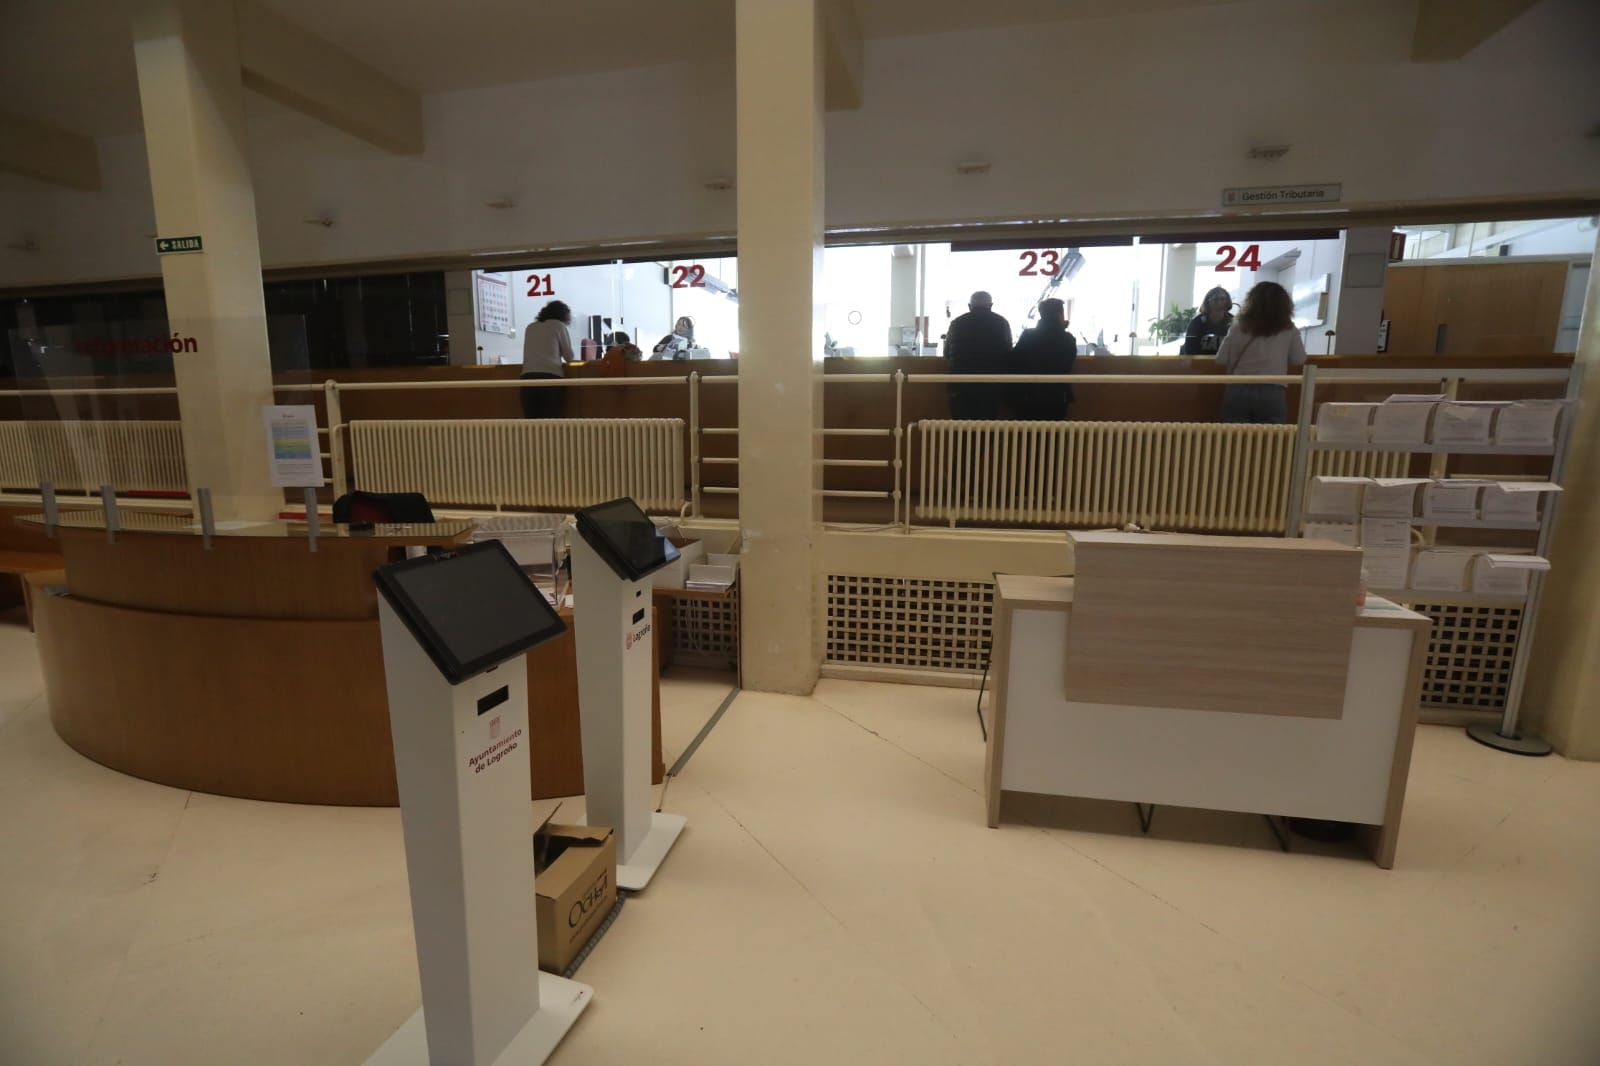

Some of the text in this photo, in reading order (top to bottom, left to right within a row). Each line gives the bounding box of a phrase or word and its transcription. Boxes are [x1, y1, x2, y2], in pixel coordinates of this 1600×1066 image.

[1242, 189, 1325, 202] Gestión Tributaria
[171, 239, 200, 251] SALIDA
[1018, 250, 1061, 276] 23
[1215, 244, 1262, 273] 24
[526, 273, 556, 297] 21
[671, 264, 707, 289] 22
[74, 332, 198, 355] nformación
[468, 728, 522, 768] Ayuntamiento
[475, 742, 518, 774] de Logroño
